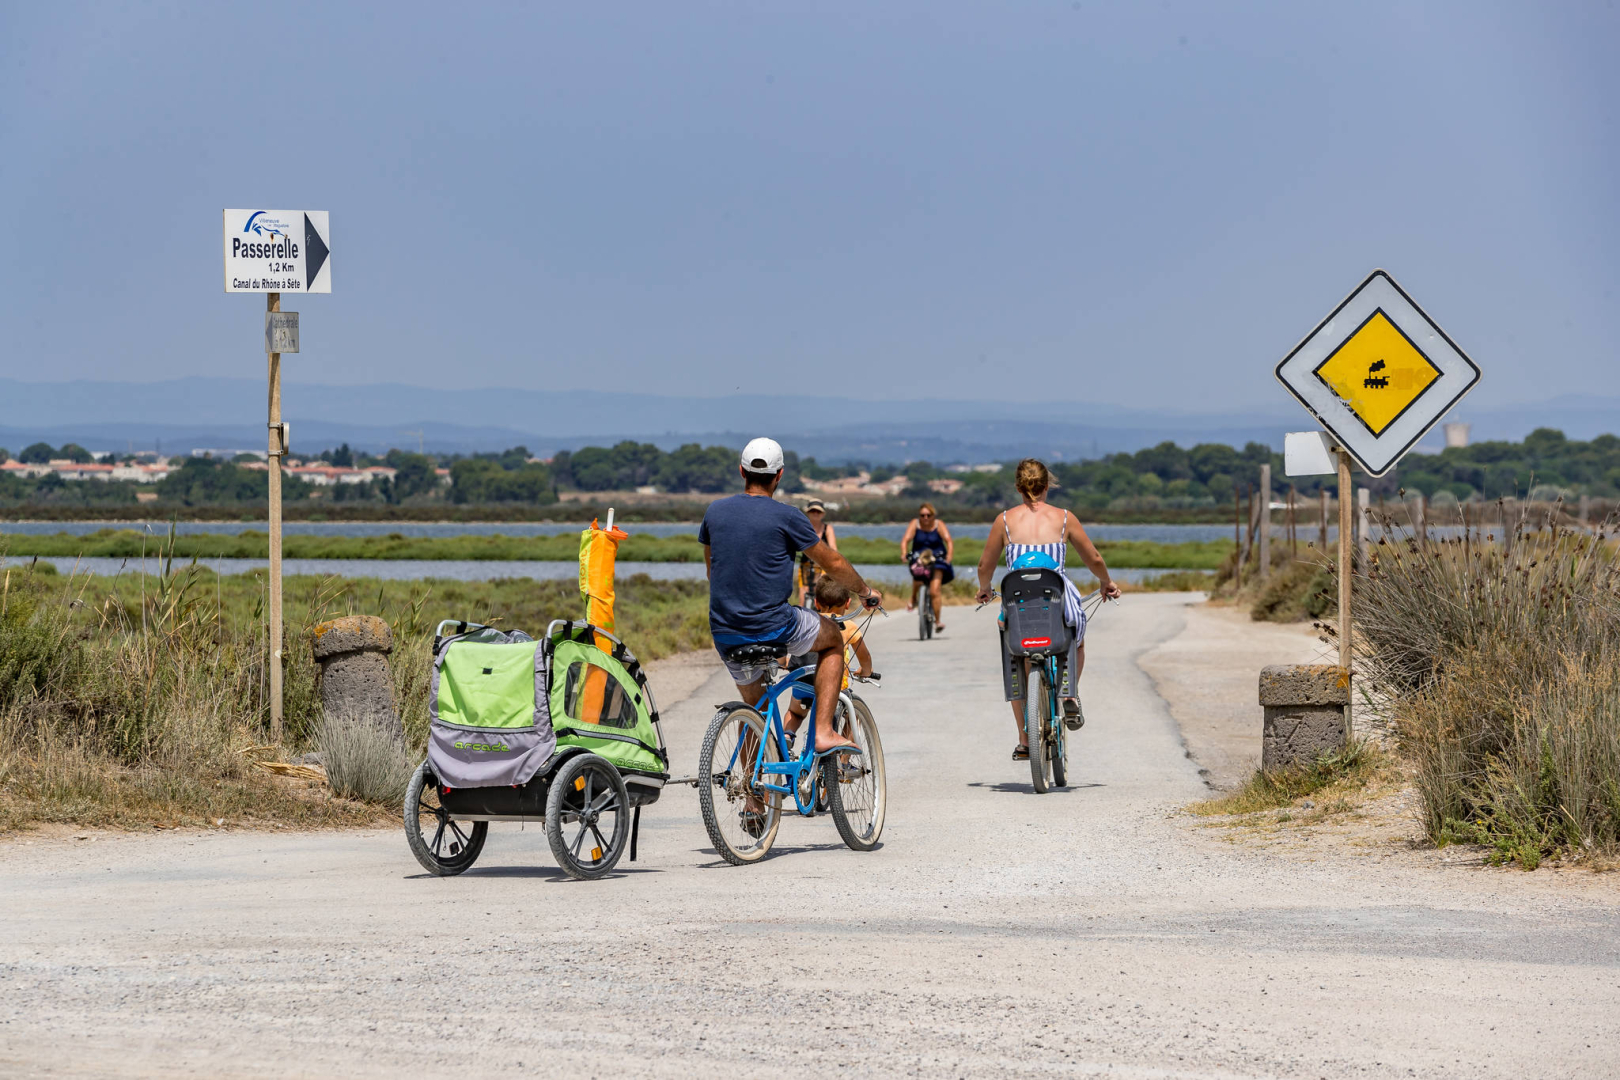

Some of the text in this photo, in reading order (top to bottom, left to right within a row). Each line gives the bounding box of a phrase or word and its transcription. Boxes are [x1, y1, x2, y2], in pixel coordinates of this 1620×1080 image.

[233, 238, 299, 258] Passerelle
[269, 263, 295, 274] 1,2 Km
[233, 278, 251, 289] Canal
[252, 278, 261, 289] du
[262, 278, 281, 289] Rhône
[287, 278, 301, 289] Sète
[454, 741, 511, 753] arcade
